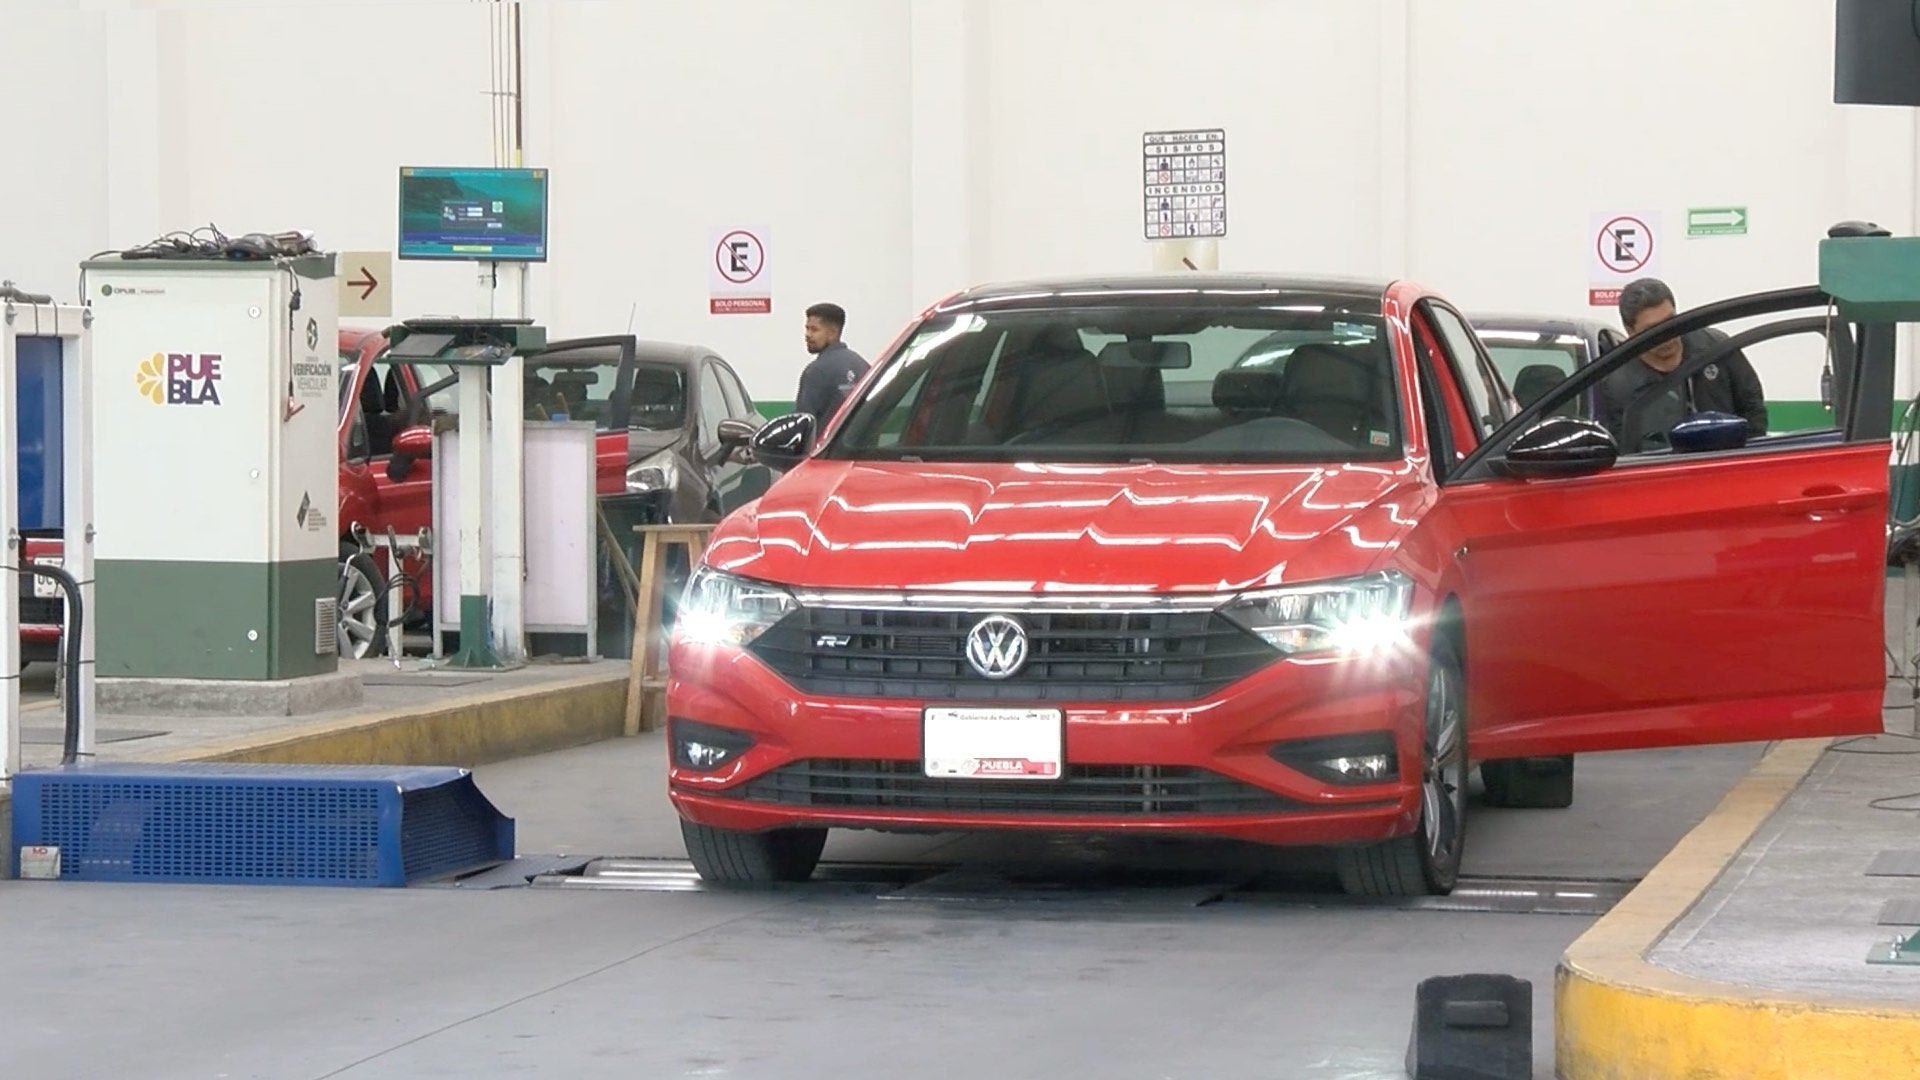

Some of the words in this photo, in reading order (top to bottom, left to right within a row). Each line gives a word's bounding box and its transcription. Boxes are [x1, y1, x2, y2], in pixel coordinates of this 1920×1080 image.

[1149, 135, 1165, 143] QUE
[1156, 144, 1214, 152] SISMOS
[1149, 186, 1220, 194] INCENDIOS
[1615, 229, 1635, 261] E
[731, 242, 748, 272] E
[982, 760, 1024, 770] PUEBLA
